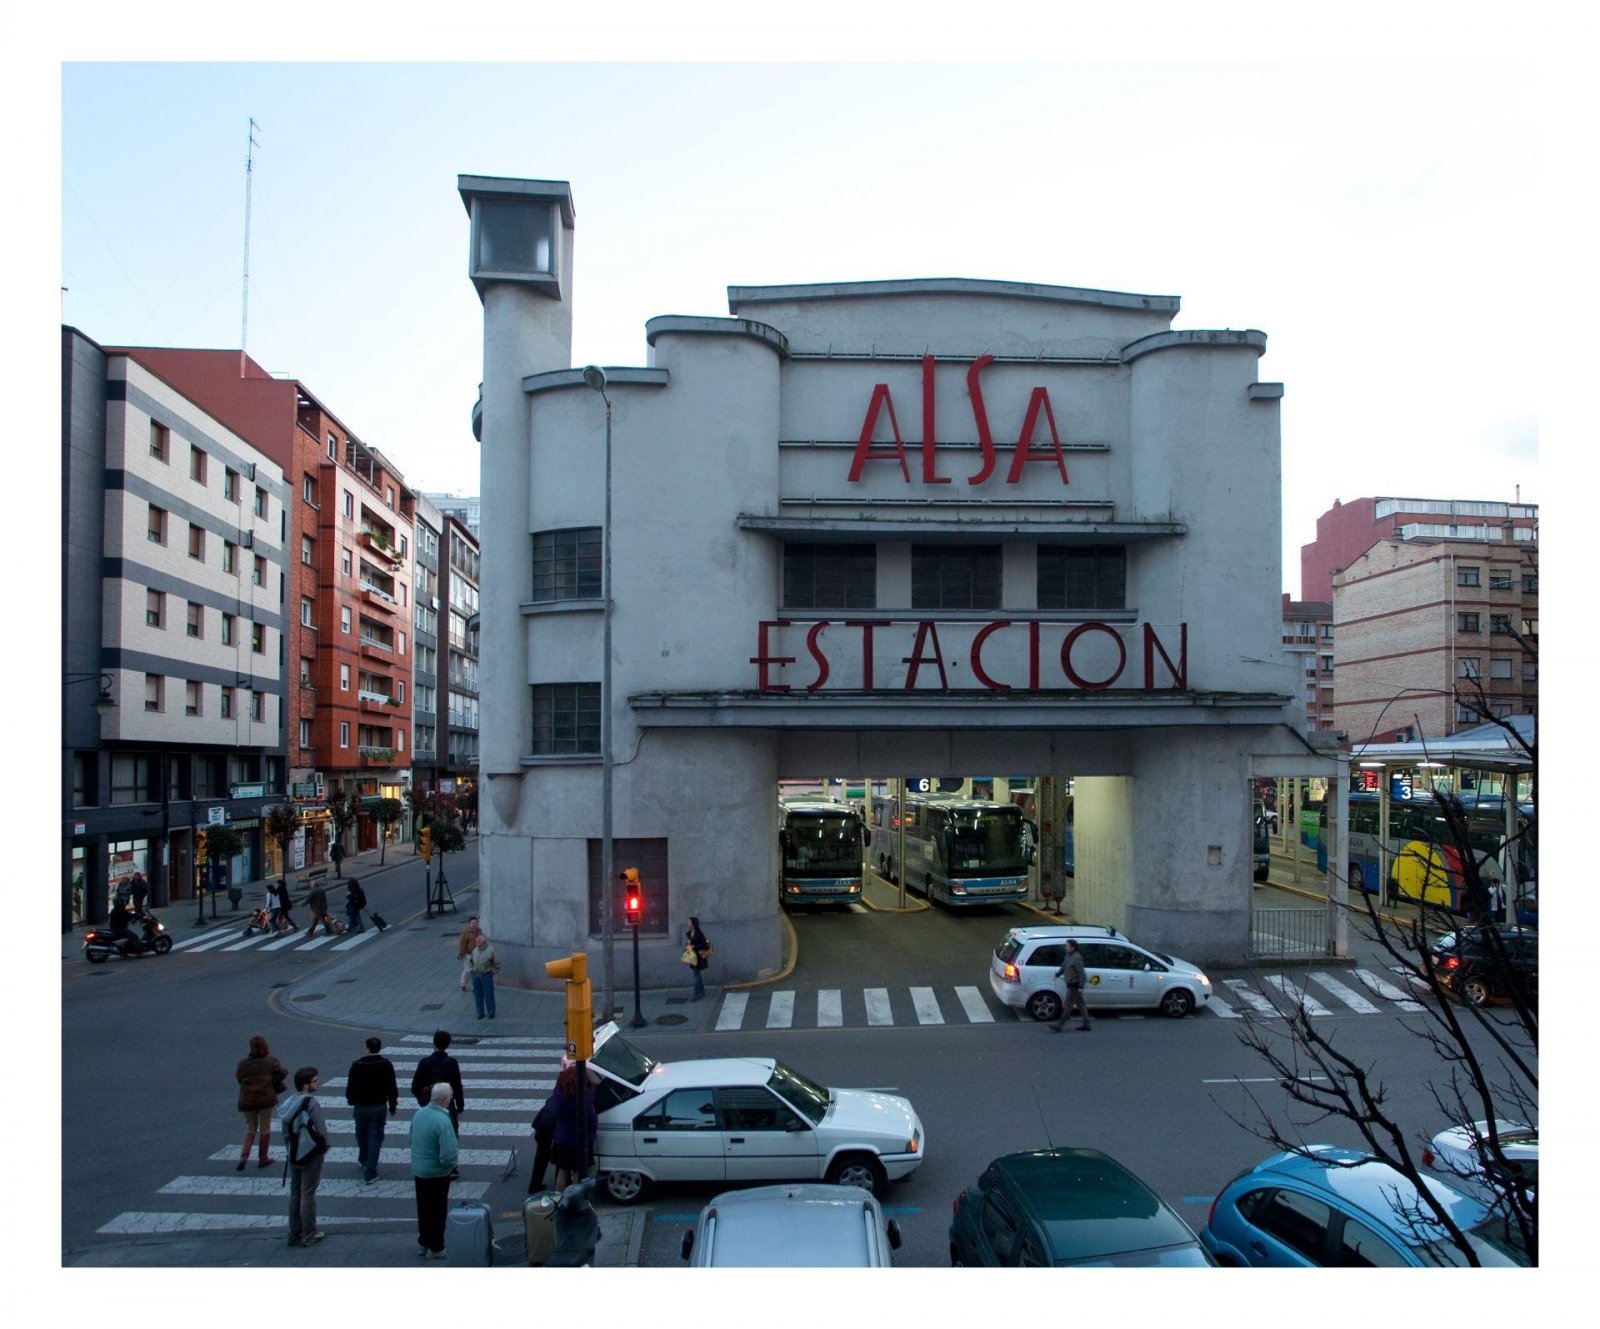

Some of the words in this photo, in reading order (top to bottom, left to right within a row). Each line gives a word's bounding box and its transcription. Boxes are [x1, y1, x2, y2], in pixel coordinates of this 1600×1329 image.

[847, 354, 1069, 485] ALSA
[749, 620, 1188, 693] ESTACION
[918, 778, 930, 792] 6
[1358, 782, 1366, 792] 2
[1470, 779, 1477, 789] 1
[1401, 786, 1413, 800] 3
